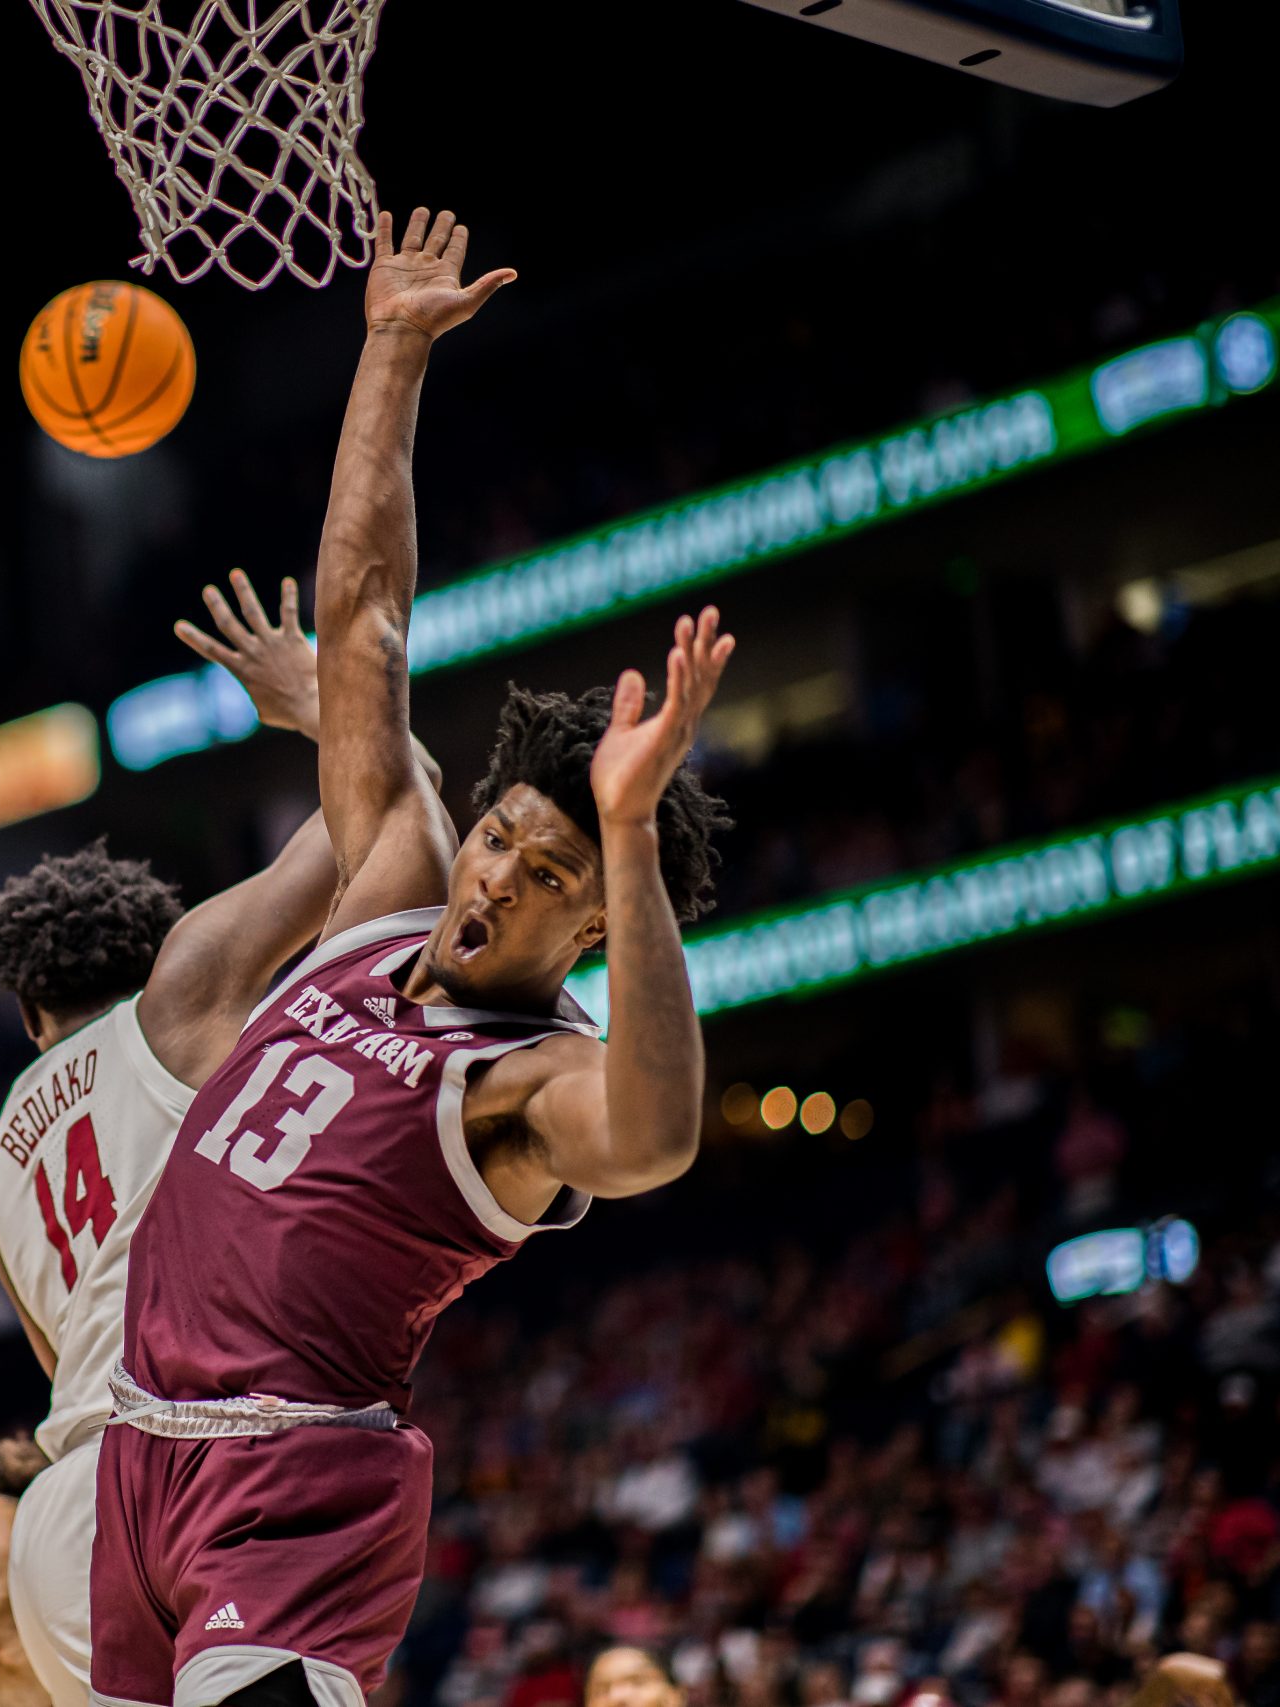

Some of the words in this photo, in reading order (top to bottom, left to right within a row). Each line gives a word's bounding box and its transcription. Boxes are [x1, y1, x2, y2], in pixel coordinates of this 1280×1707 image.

[363, 997, 396, 1029] adidas
[353, 1032, 435, 1089] A&M
[0, 1049, 97, 1169] BEDIAKO
[194, 1040, 355, 1192] 13
[35, 1112, 118, 1294] 14
[205, 1620, 245, 1631] adidas
